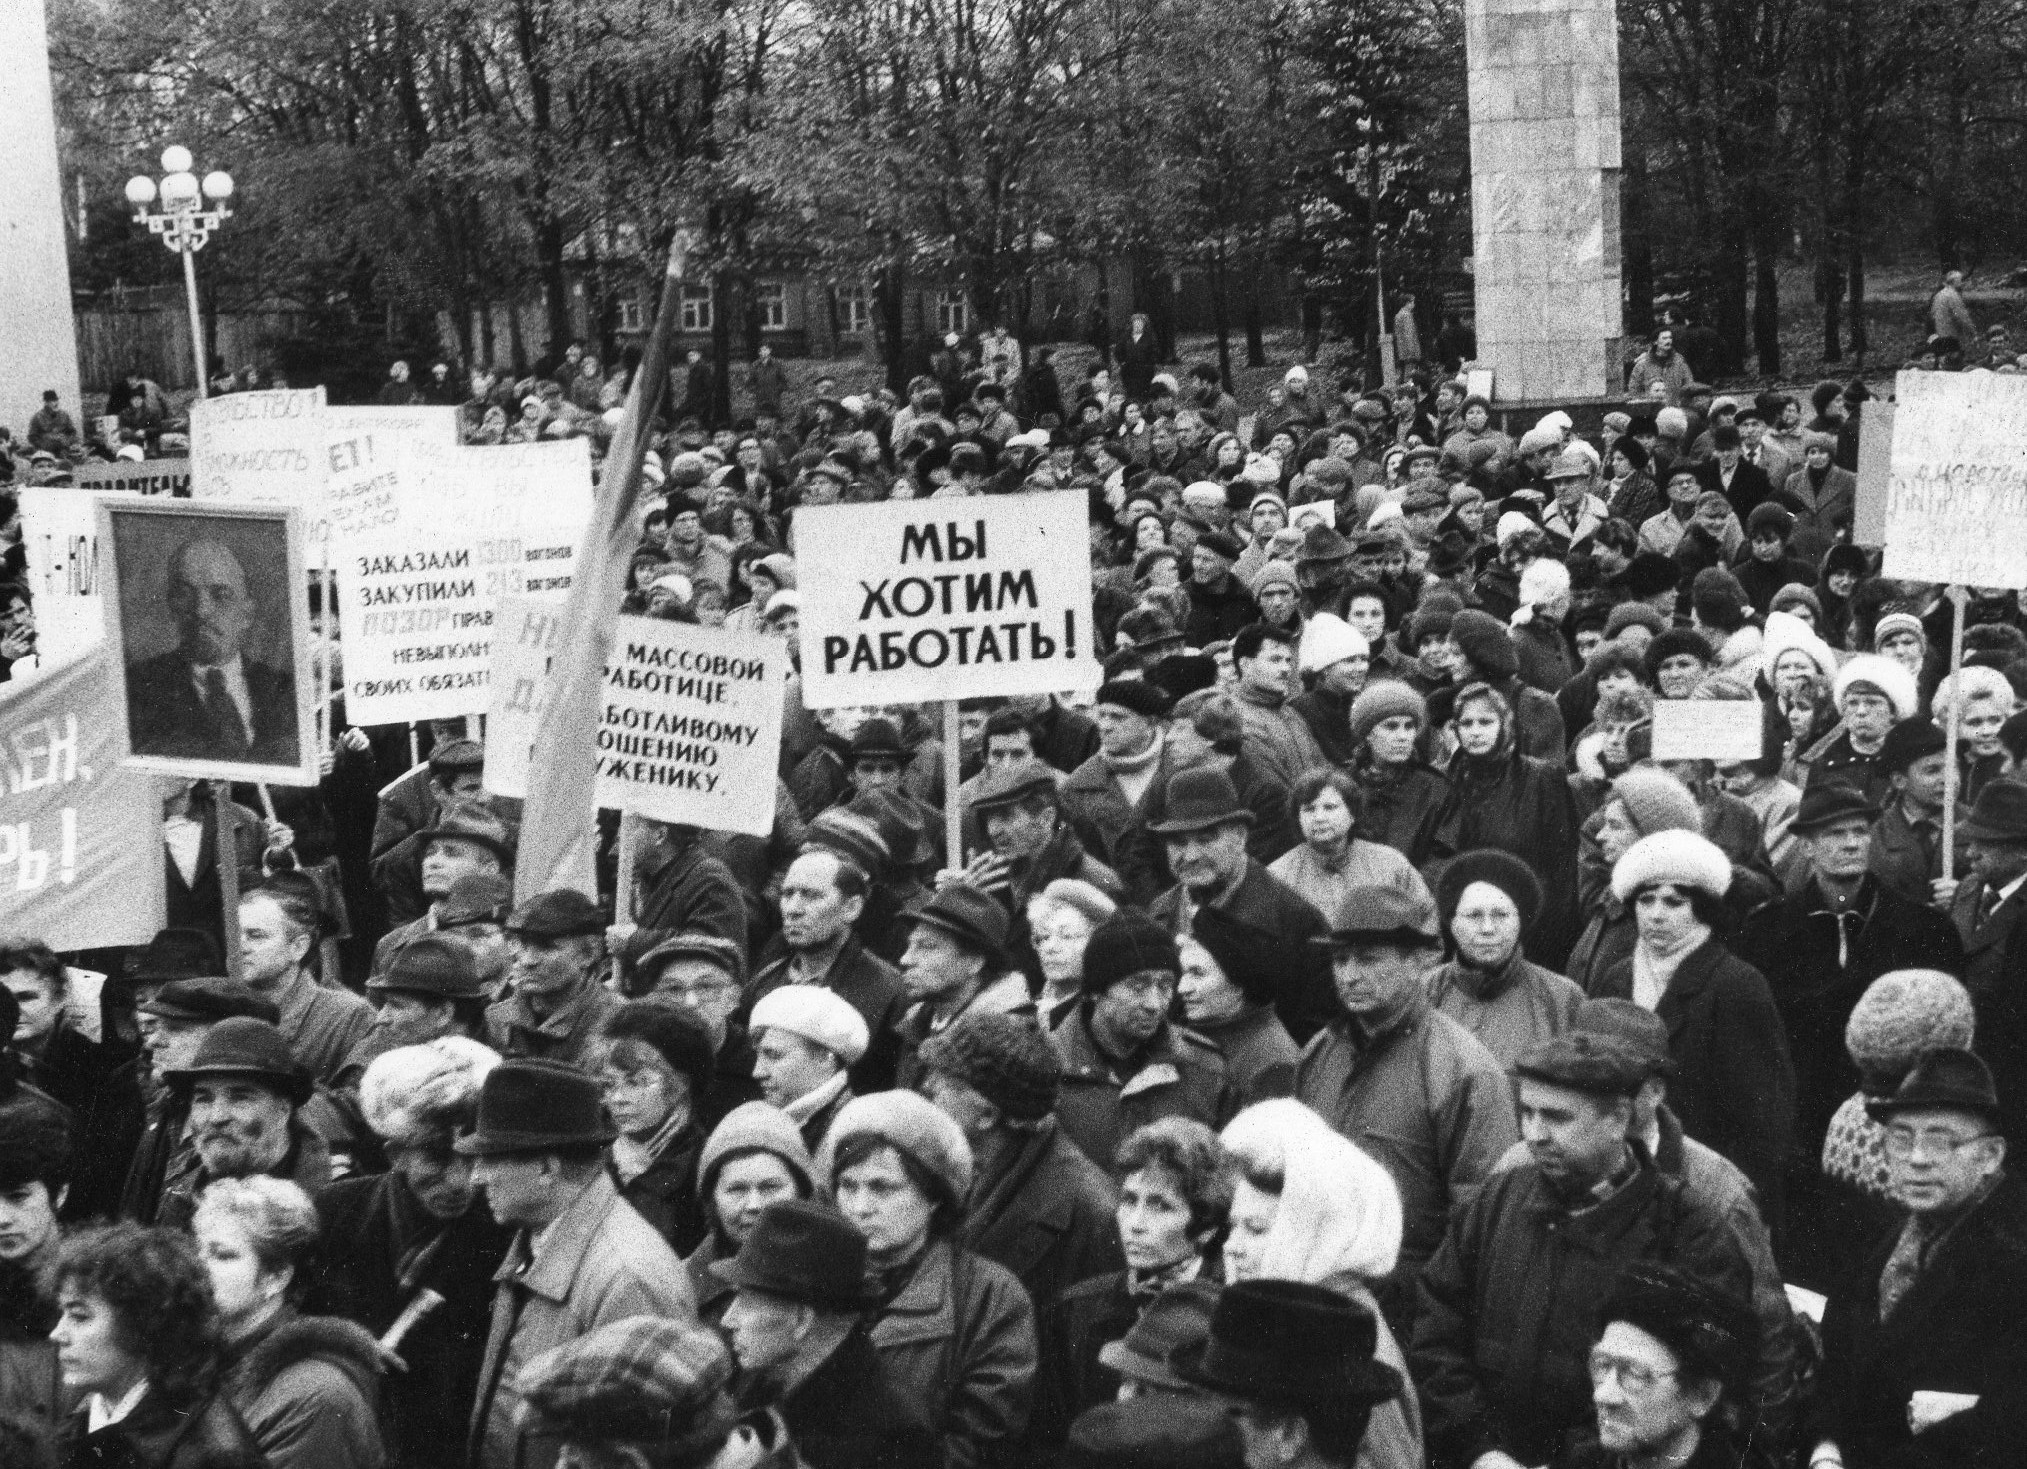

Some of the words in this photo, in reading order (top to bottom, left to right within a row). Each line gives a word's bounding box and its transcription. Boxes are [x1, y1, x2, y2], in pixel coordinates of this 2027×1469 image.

[357, 549, 469, 576] ЗАКАЗАЛИ
[900, 519, 986, 564] МЫ
[360, 579, 475, 607] ЗАКУПИЛИ
[858, 569, 1038, 621] ХОТИМ
[824, 609, 1076, 674] РАБОТАТЬ!
[598, 704, 759, 746] БОТЛИВОМУ
